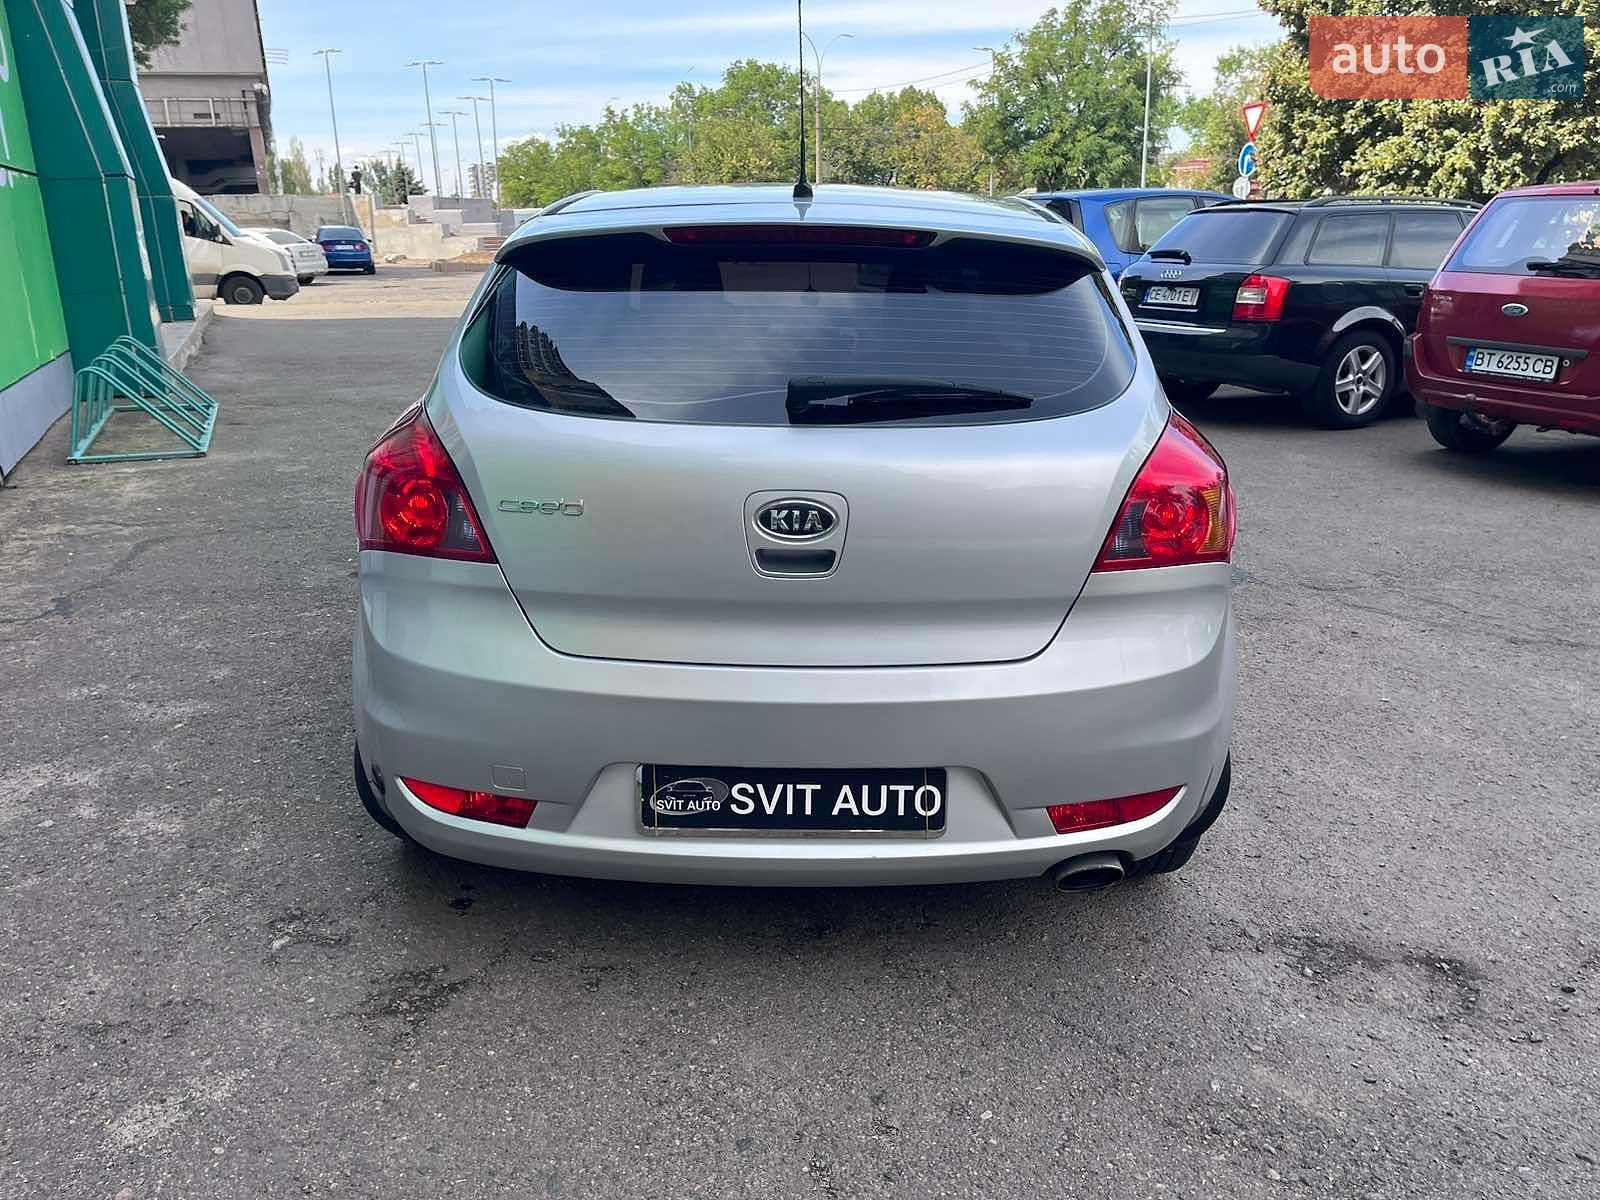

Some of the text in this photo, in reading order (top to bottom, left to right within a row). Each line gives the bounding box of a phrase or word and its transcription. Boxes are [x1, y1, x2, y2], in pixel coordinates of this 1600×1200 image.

[1474, 351, 1556, 375] BT 6255 CB
[769, 509, 824, 531] KIA
[656, 799, 721, 811] SVIT AUTO
[730, 782, 942, 817] SVIT AUTO
